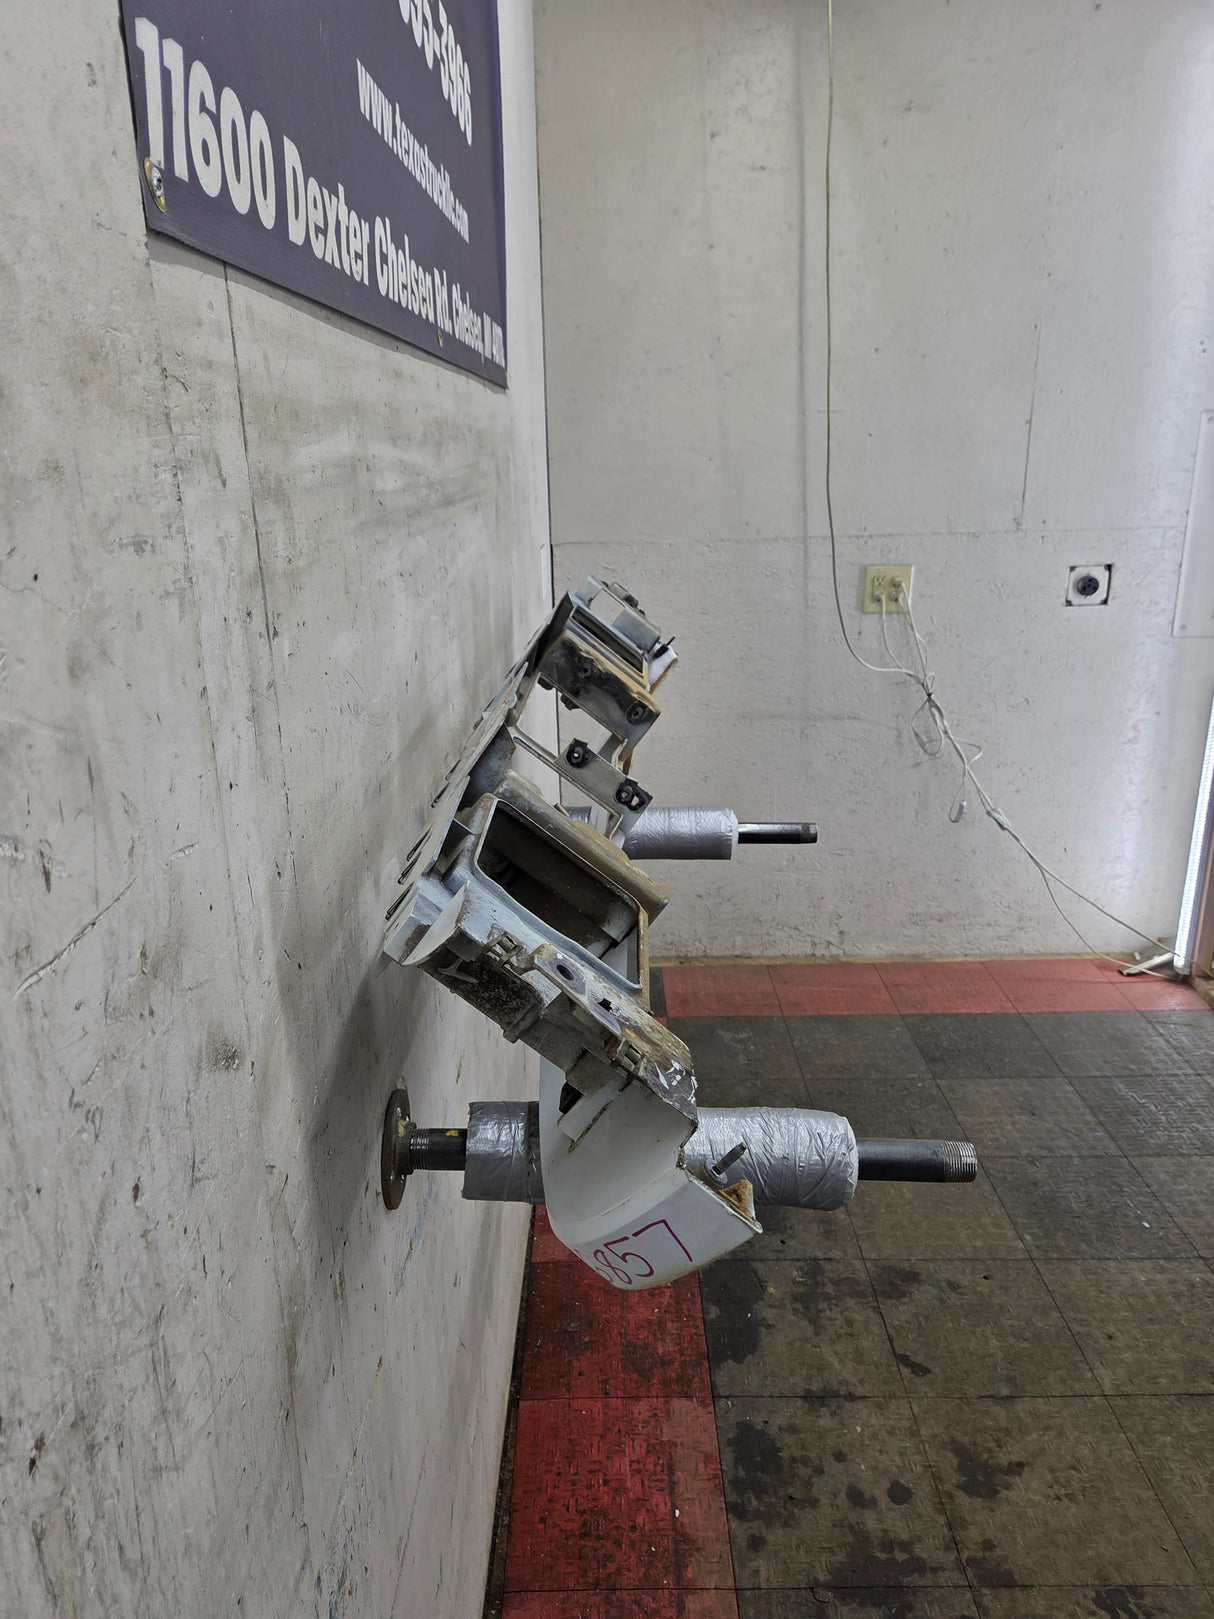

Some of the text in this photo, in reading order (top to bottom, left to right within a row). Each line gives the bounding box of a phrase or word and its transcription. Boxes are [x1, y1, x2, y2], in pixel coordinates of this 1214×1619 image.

[135, 17, 276, 229] 11600
[283, 135, 370, 286] Dexter
[375, 216, 435, 324] Chelsea
[434, 267, 452, 335] Rd.
[398, 0, 472, 146] 5-3966
